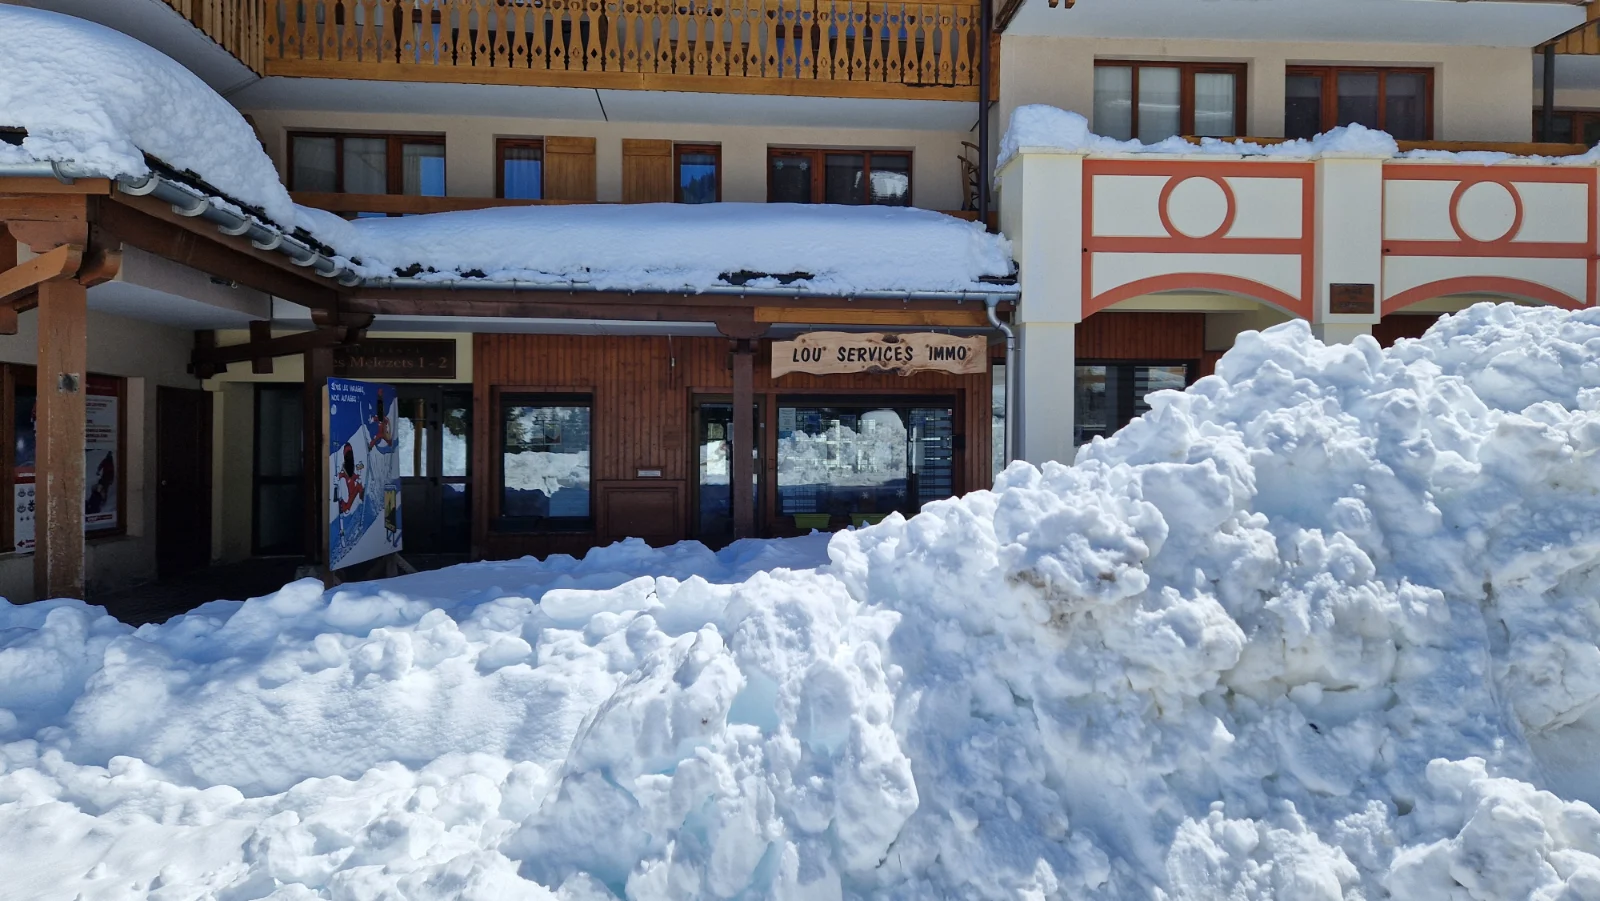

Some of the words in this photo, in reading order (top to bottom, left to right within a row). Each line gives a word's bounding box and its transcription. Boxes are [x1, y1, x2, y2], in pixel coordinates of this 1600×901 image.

[792, 347, 822, 362] LOU
[837, 346, 914, 362] SERVICES
[928, 346, 967, 361] IMMO
[350, 356, 414, 368] Melezets
[418, 356, 425, 368] 1
[438, 356, 448, 368] 2
